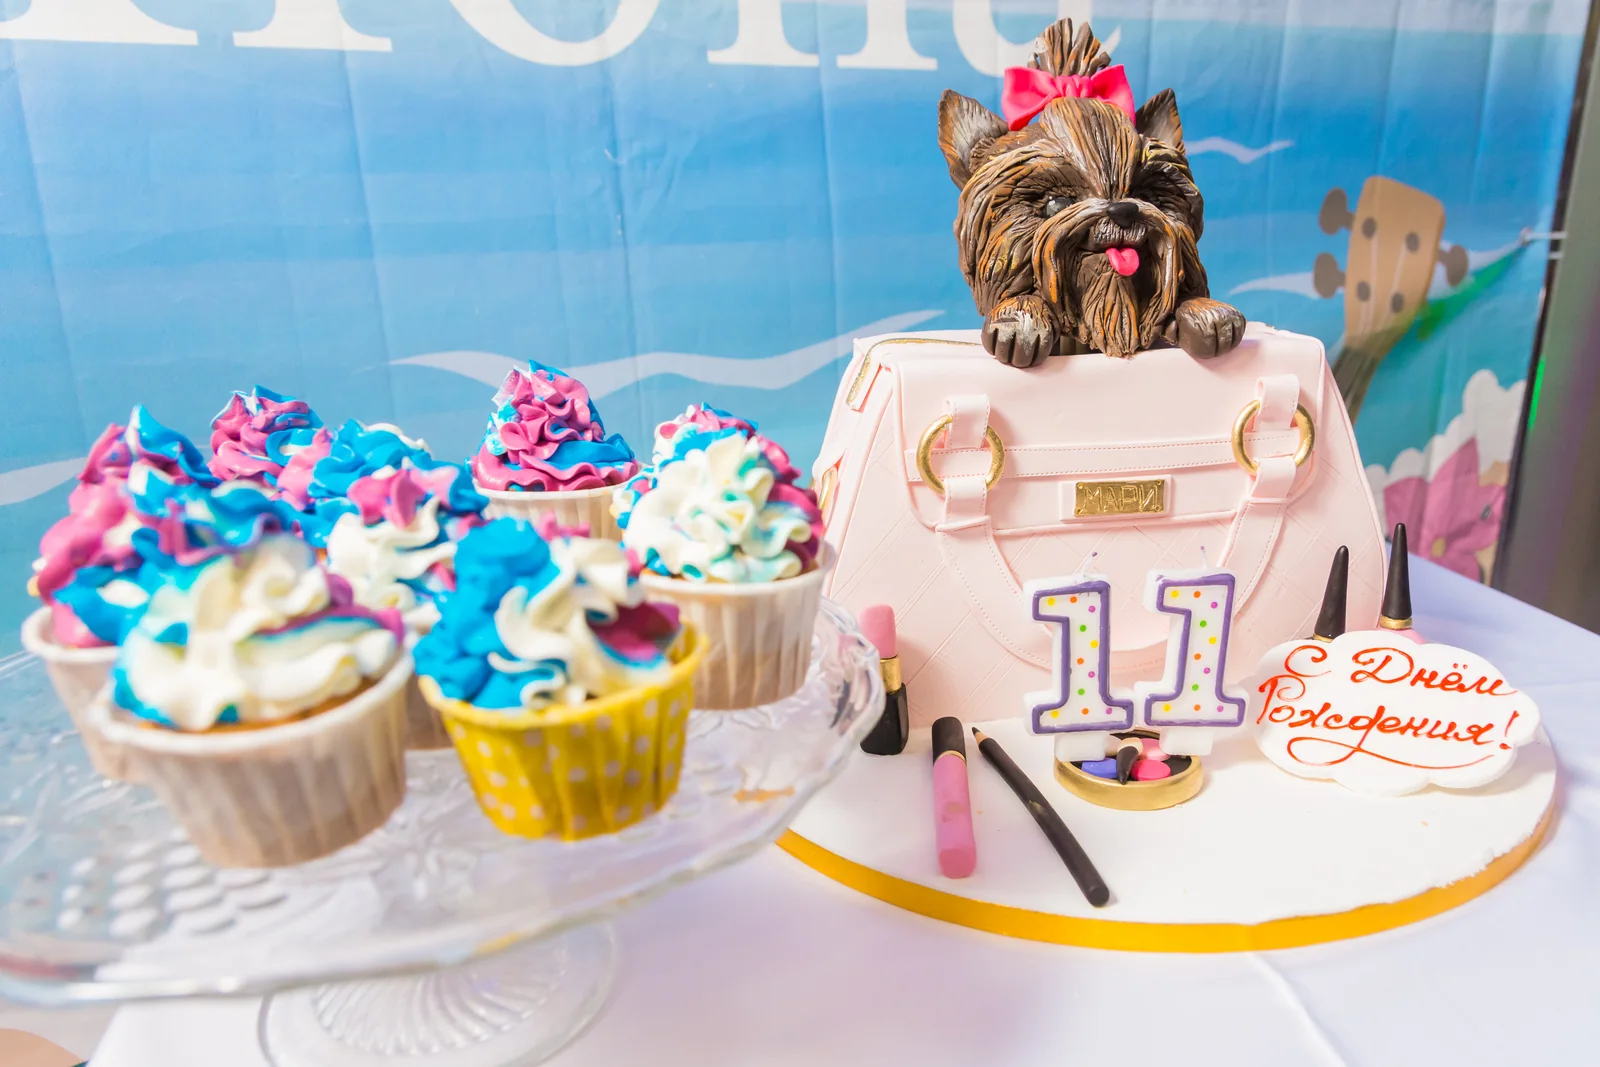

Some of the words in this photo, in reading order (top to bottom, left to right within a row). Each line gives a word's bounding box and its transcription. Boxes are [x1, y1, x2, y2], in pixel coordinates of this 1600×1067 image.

[1083, 484, 1158, 513] МАРИ
[1031, 572, 1247, 735] 11
[1284, 644, 1332, 678] С
[1350, 647, 1518, 697] Днём
[1256, 674, 1520, 770] Рождения!
